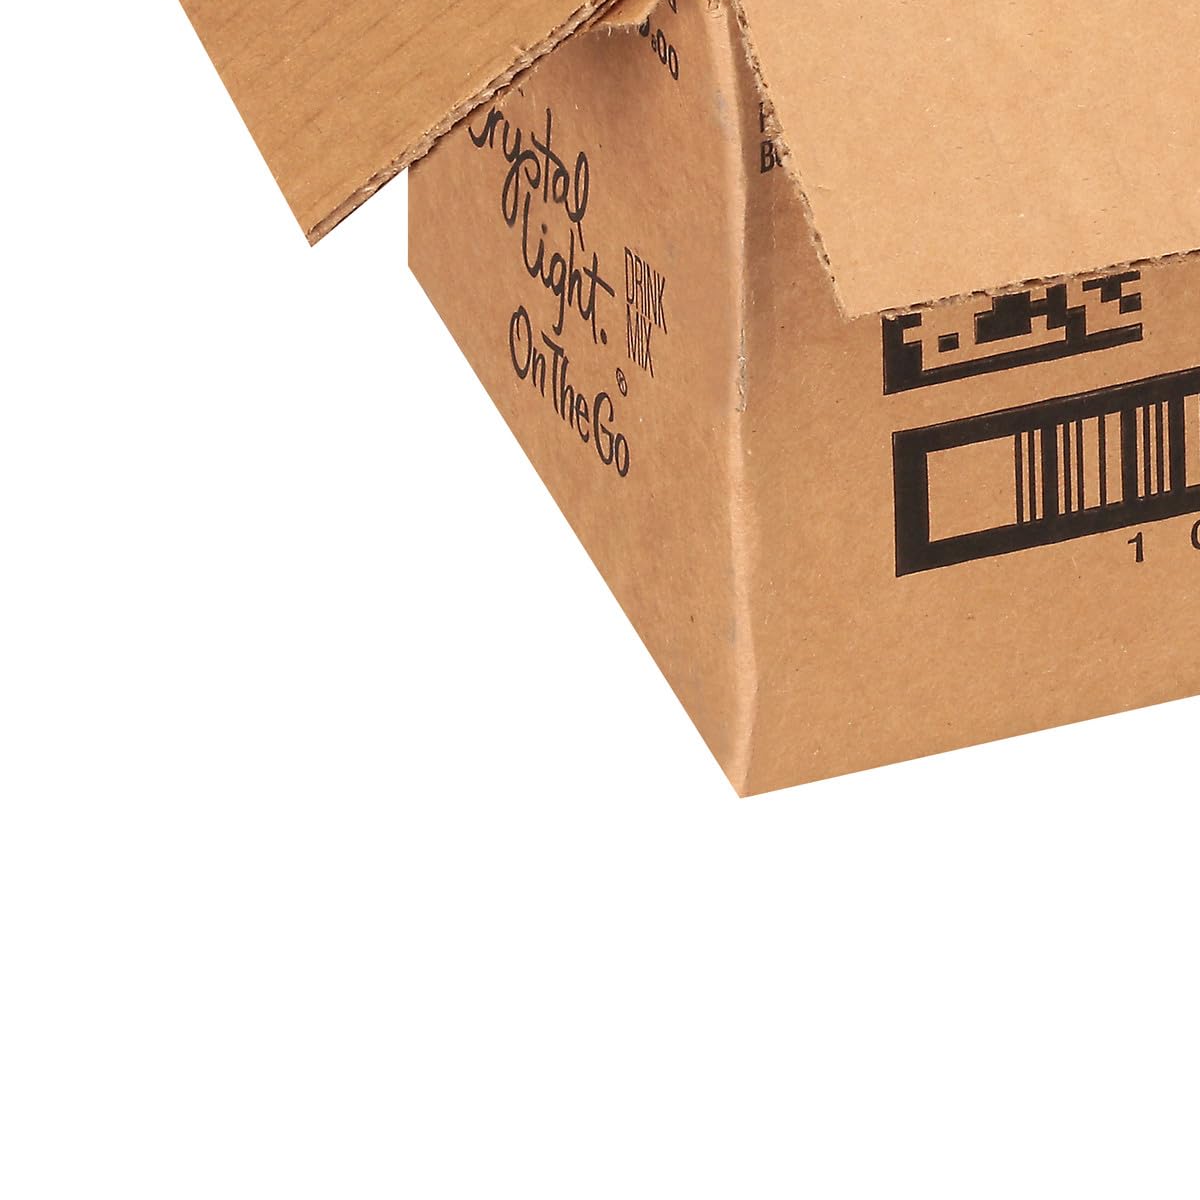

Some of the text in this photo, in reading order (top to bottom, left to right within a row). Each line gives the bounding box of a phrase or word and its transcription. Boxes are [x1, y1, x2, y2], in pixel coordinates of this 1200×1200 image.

[468, 106, 590, 252] rystal
[623, 246, 668, 335] DRINK
[626, 302, 654, 379] MIX
[509, 304, 630, 478] On The Go
[1127, 531, 1144, 564] 1
